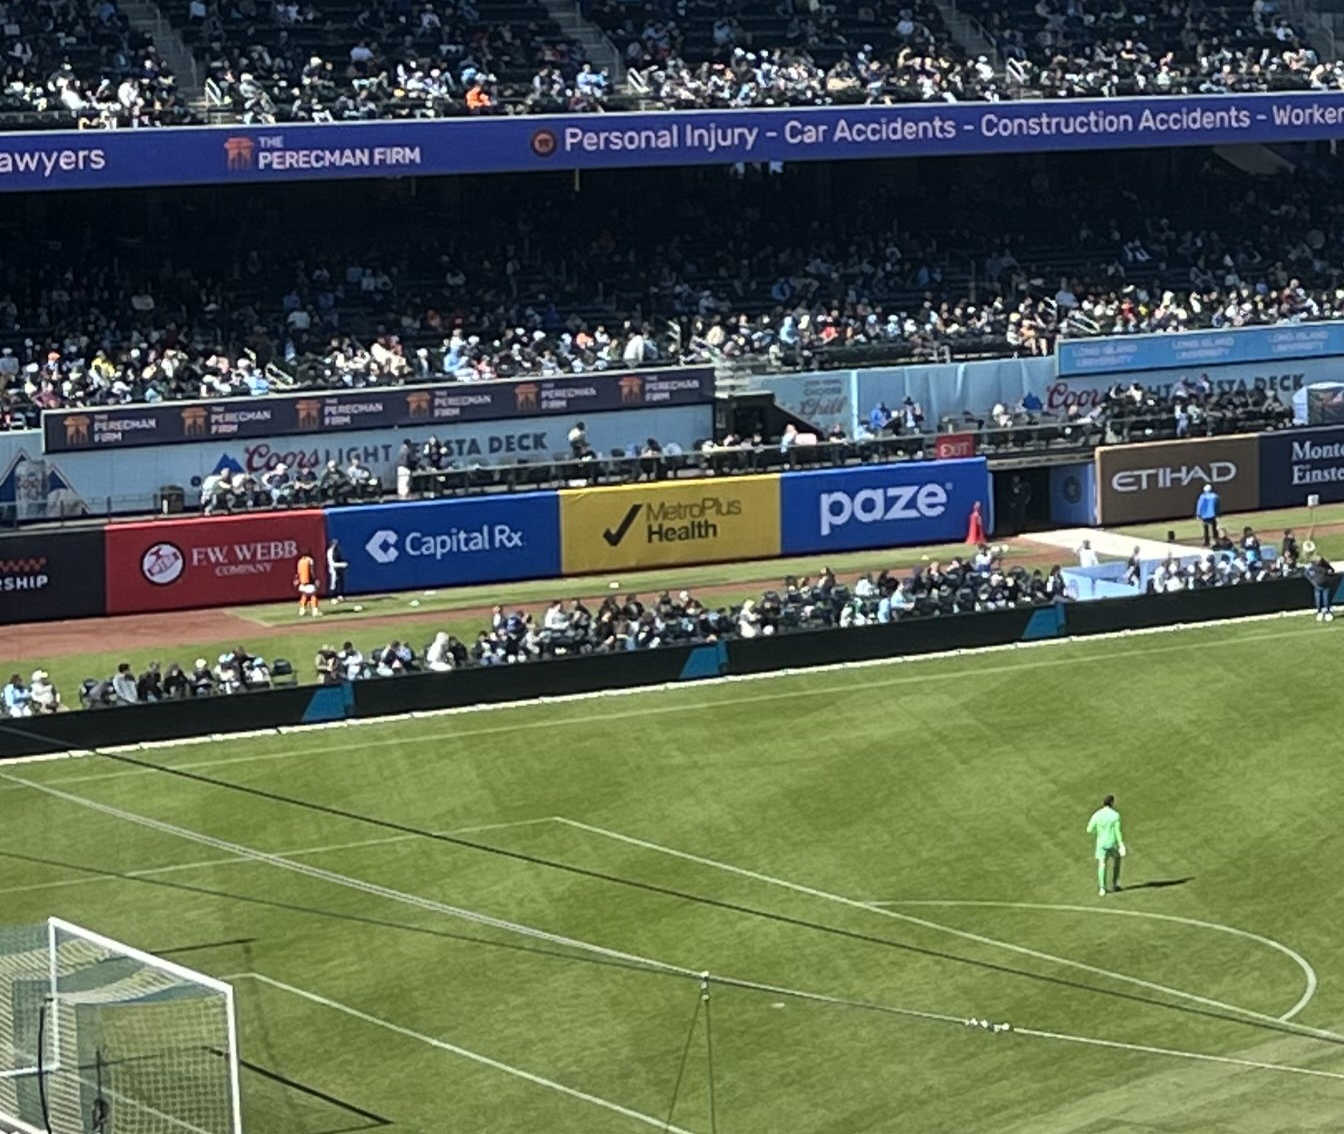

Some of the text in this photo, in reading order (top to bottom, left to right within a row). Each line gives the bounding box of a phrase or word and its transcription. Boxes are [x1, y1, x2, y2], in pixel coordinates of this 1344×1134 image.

[564, 124, 679, 152] Personal
[685, 122, 759, 152] Injury
[785, 119, 829, 145] Car
[833, 114, 957, 143] Accidents
[980, 108, 1135, 138] Construction
[1137, 104, 1251, 133] Accidents
[259, 136, 285, 149] THE
[258, 147, 422, 170] PERECMAN FIRM
[244, 432, 549, 472] Coors LIGHT DECK
[939, 441, 971, 457] EXIT
[1111, 460, 1237, 493] ETIHAD
[646, 497, 742, 522] MetroPlus
[820, 480, 948, 536] paze
[405, 524, 524, 560] Capital Rx
[647, 518, 717, 544] Health
[233, 540, 298, 562] WEBB
[214, 562, 274, 577] COMPANY
[0, 575, 49, 592] SHIP
